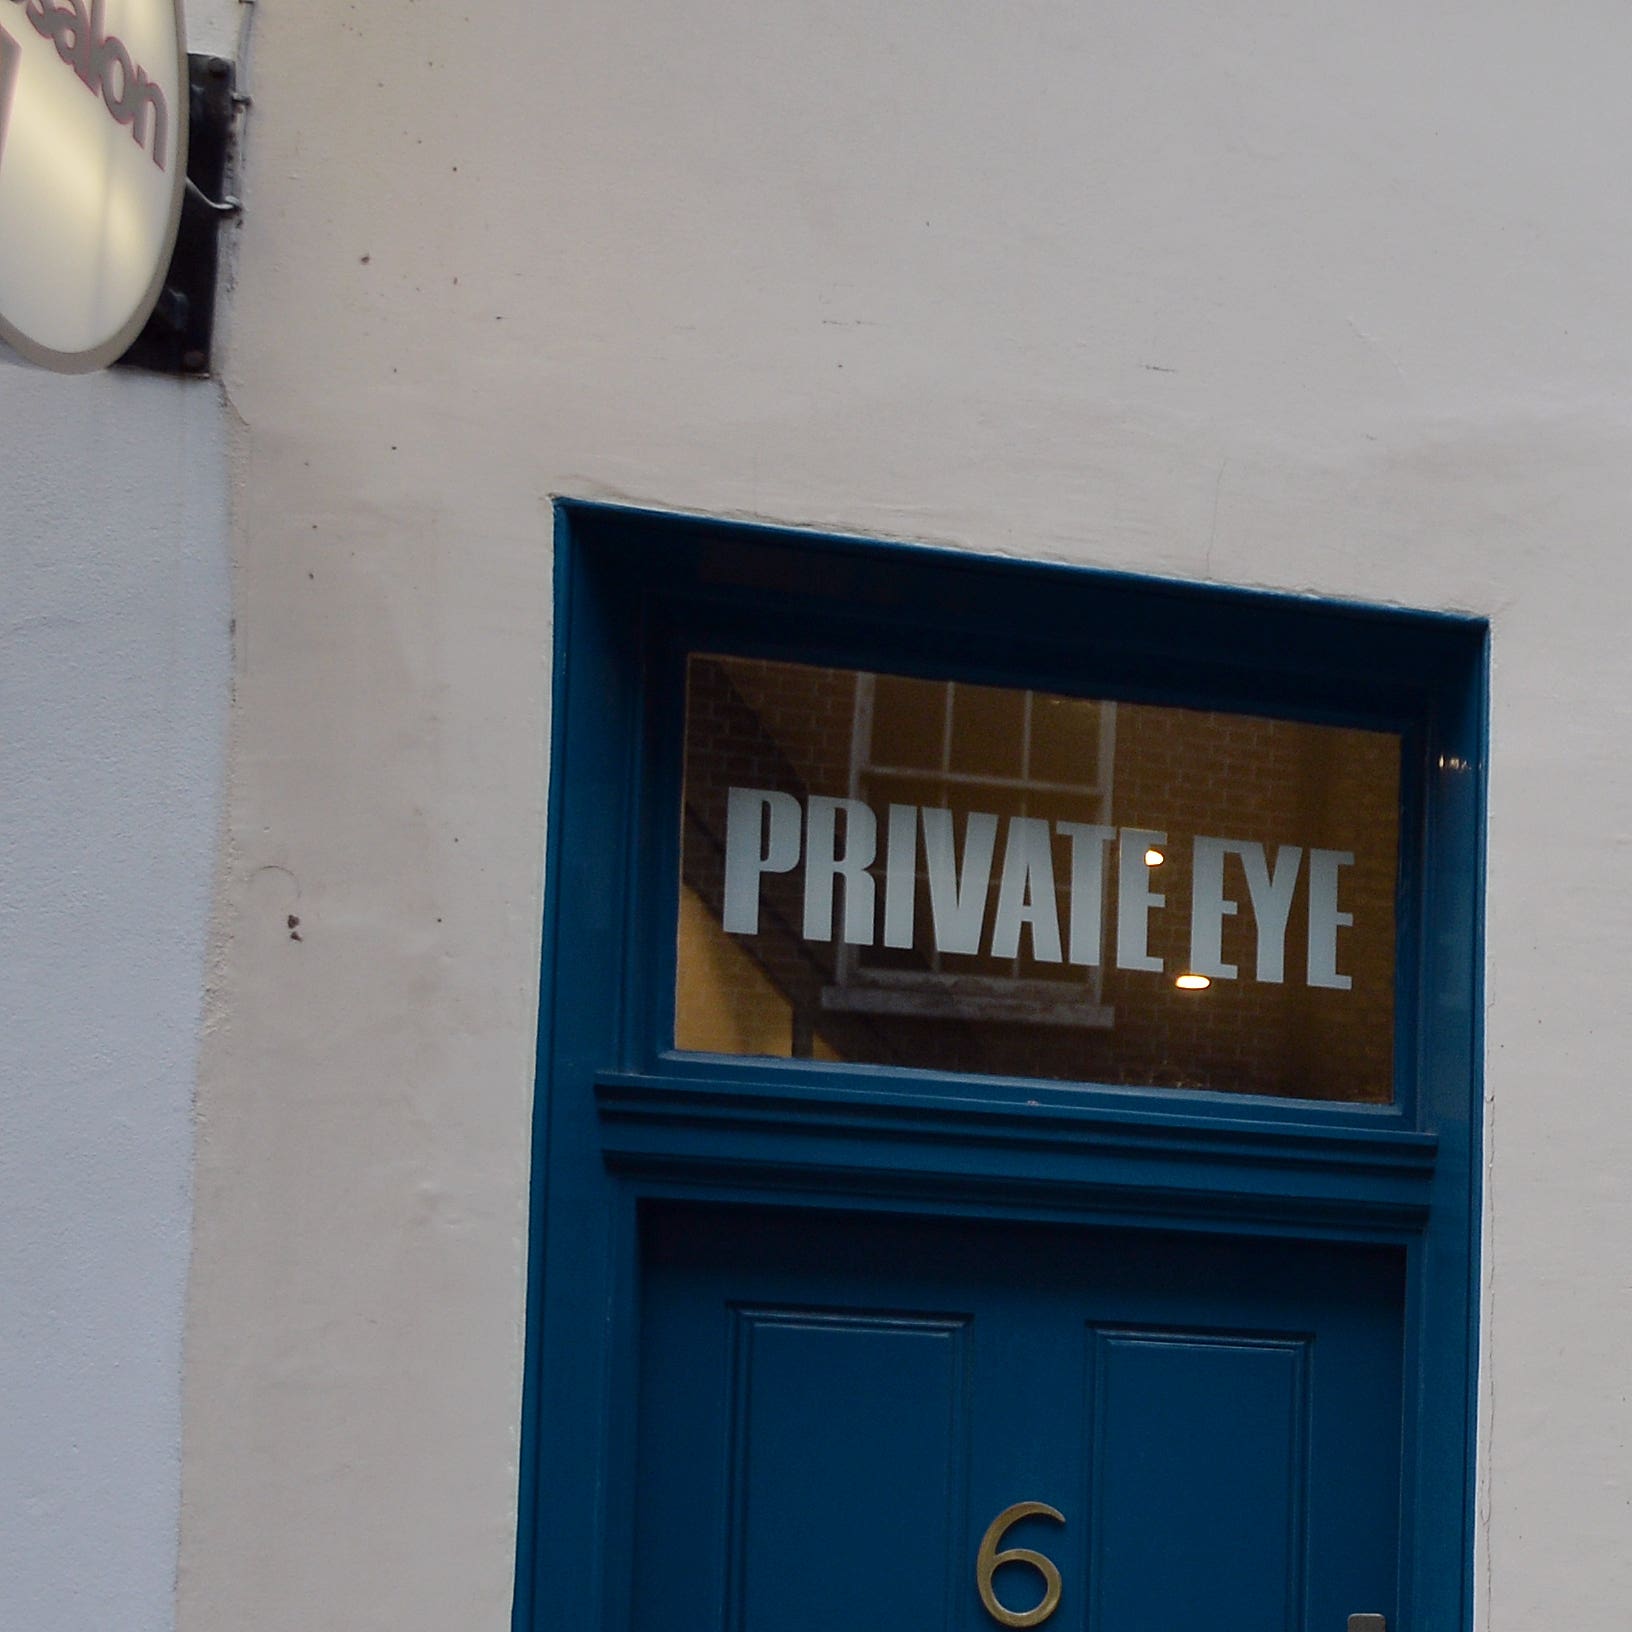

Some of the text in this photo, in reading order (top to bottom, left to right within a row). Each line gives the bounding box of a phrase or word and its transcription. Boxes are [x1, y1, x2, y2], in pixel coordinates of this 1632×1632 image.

[722, 786, 1355, 990] PRIVATE EYE
[976, 1501, 1066, 1628] 6
